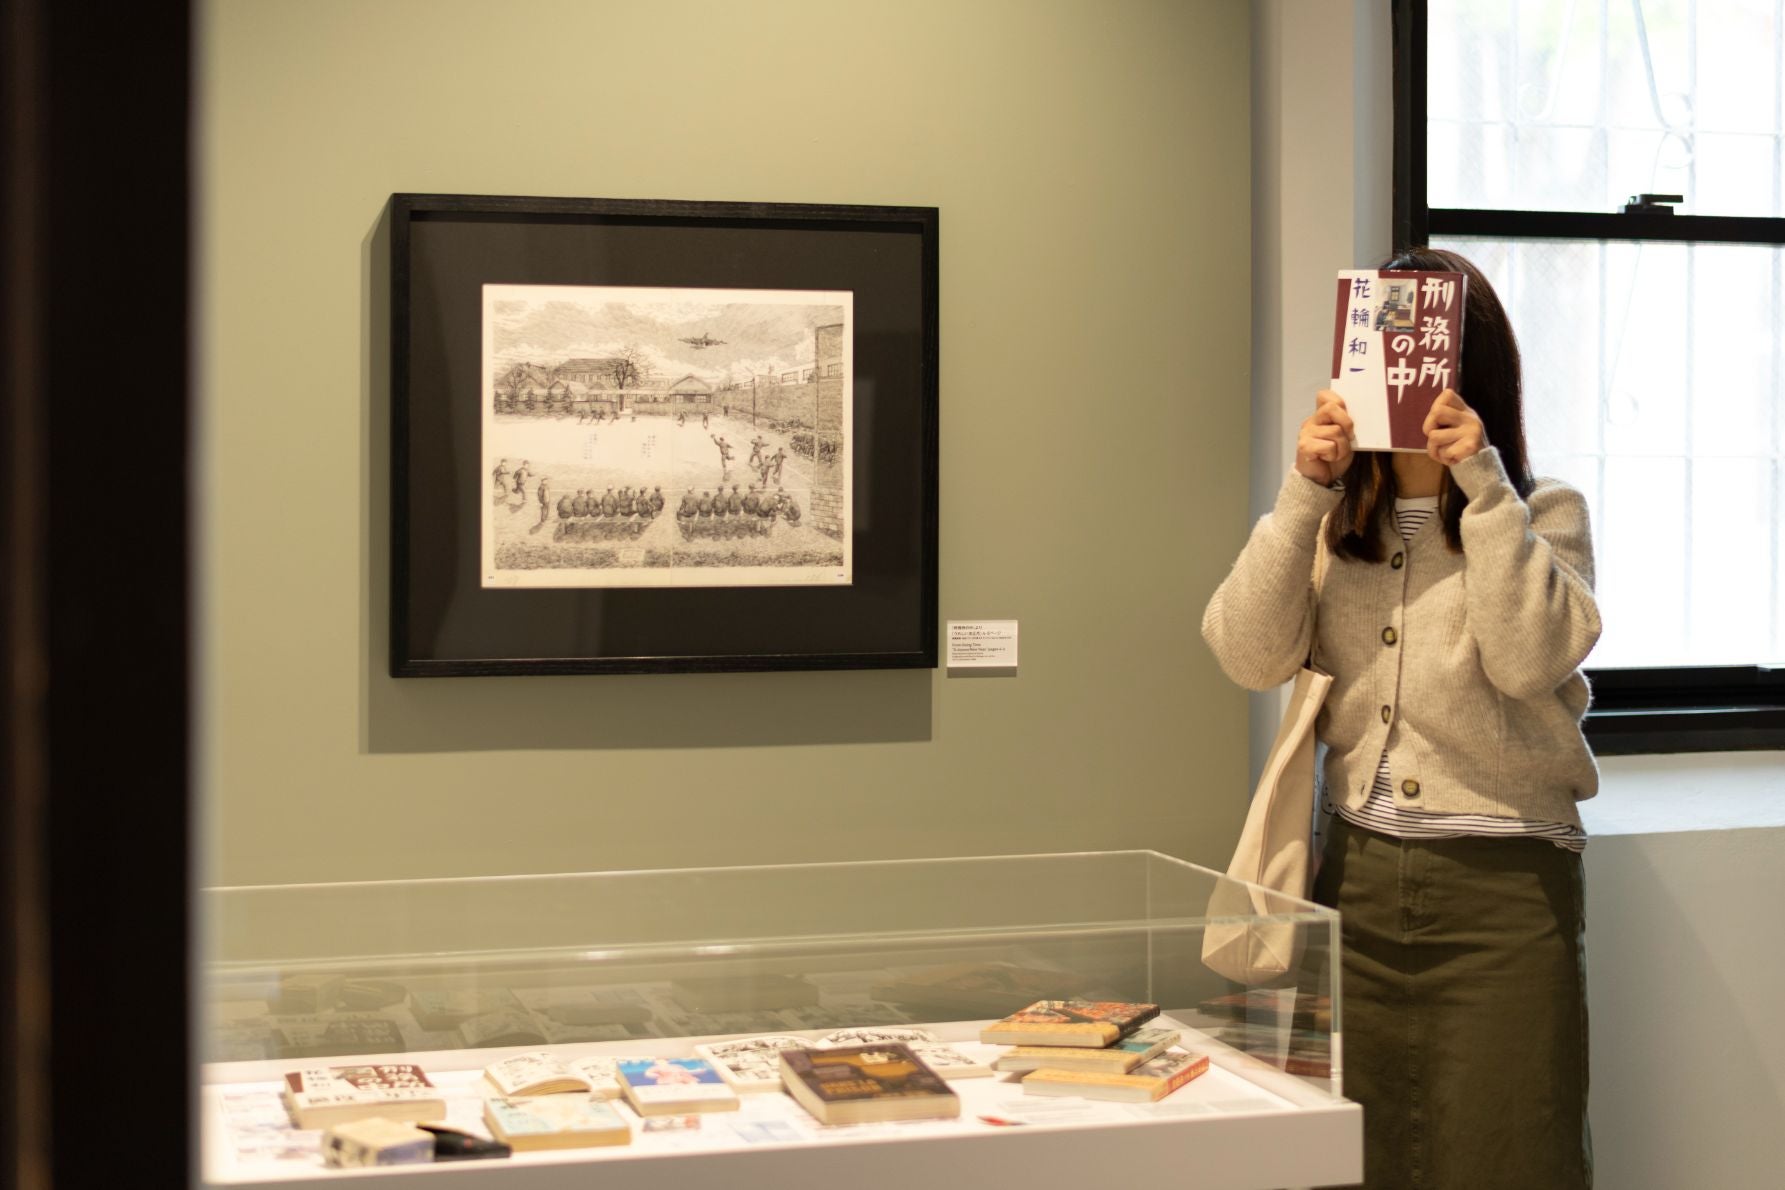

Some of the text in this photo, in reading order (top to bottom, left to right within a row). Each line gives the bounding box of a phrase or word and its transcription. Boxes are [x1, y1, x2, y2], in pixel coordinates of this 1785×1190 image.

[1349, 277, 1371, 372] 花輪和一
[1387, 334, 1416, 404] の中
[1418, 277, 1455, 390] 刑務所
